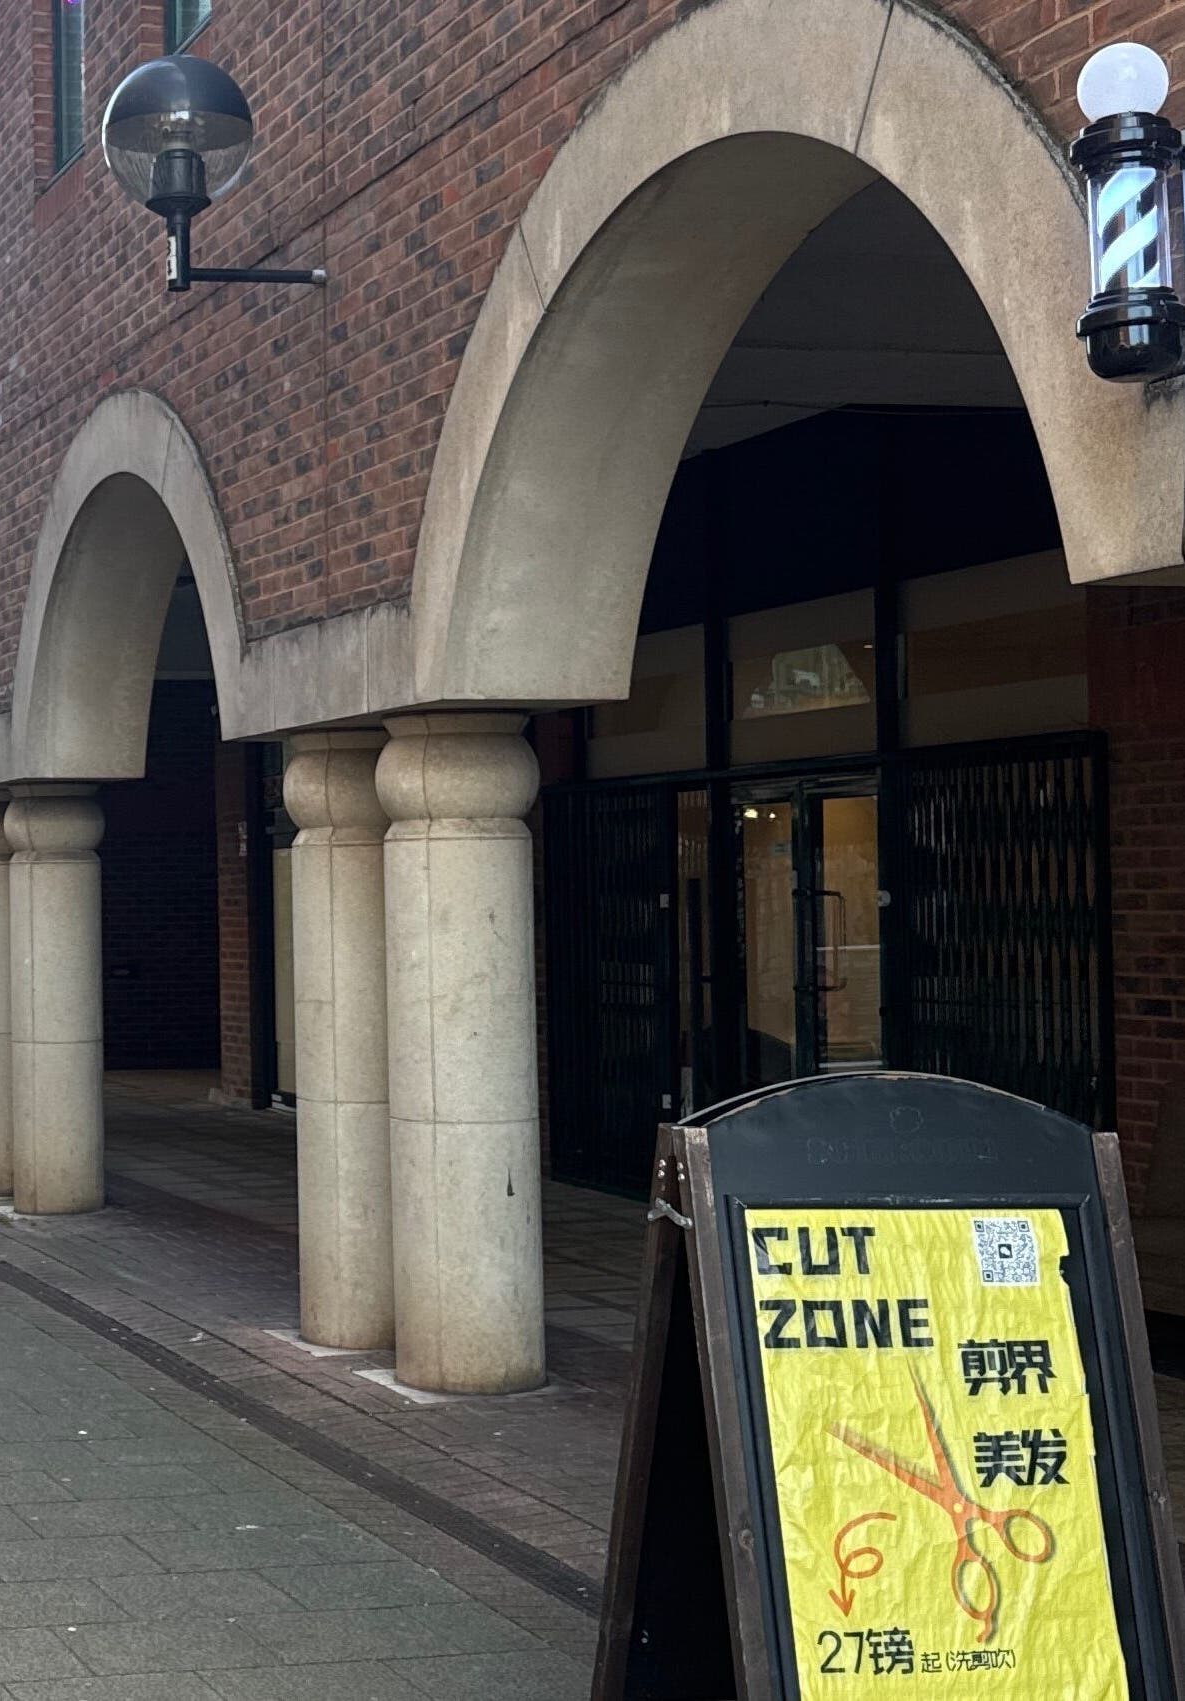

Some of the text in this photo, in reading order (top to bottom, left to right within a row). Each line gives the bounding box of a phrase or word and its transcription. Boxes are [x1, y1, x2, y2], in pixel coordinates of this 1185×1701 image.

[752, 1226, 876, 1276] CUT
[759, 1298, 934, 1349] ZONE
[957, 1338, 1057, 1396] 剪界
[973, 1428, 1070, 1488] 美发
